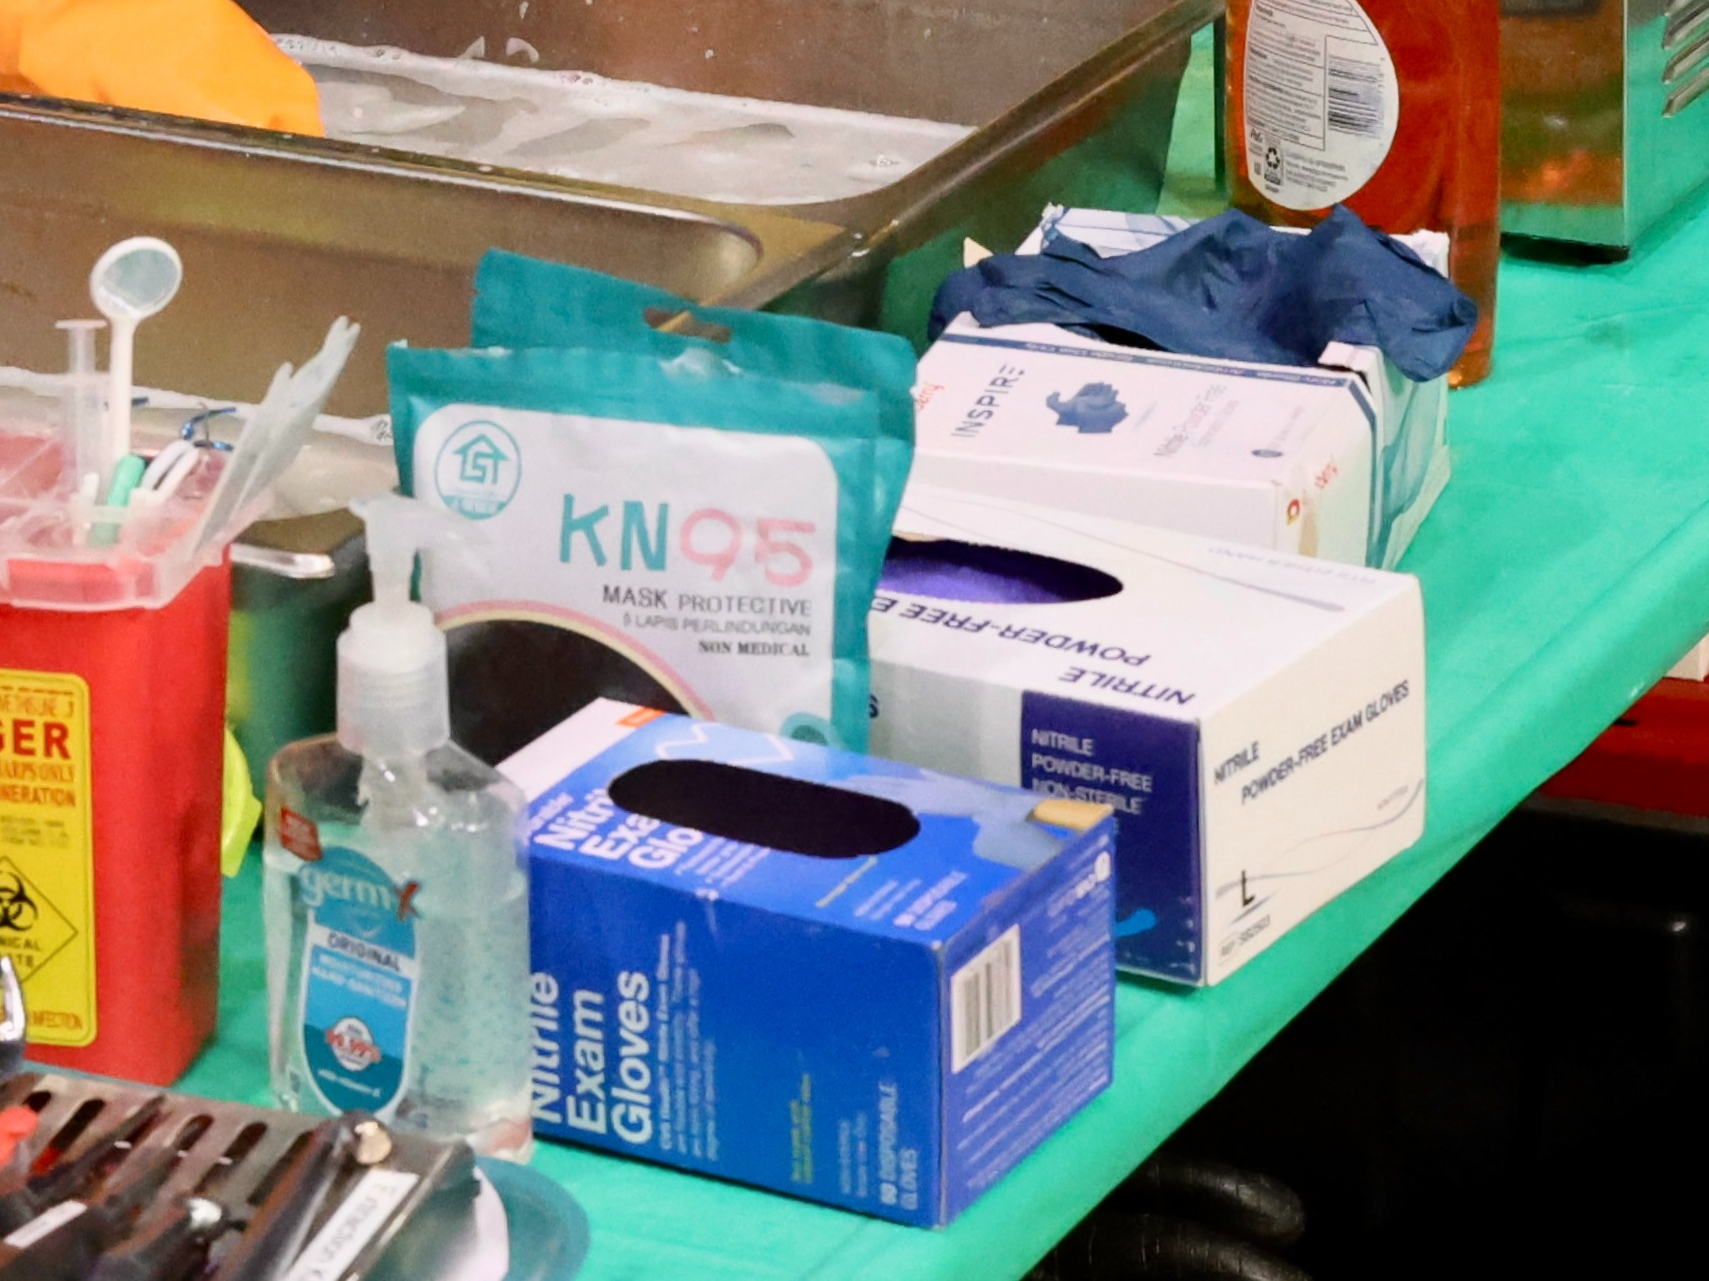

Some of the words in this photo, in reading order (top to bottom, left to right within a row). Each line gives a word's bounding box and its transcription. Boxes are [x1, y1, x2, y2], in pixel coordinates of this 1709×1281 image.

[951, 364, 1026, 439] INSPIRE
[558, 493, 817, 588] KN95
[602, 584, 668, 610] MASK
[678, 593, 812, 618] PROTECTIVE
[635, 614, 679, 631] LAPIS
[681, 616, 812, 637] PERLINDUNGAN
[698, 640, 732, 655] NON
[736, 641, 811, 657] MEDICAL
[899, 600, 1151, 667] POWDER-FREE
[1056, 664, 1195, 705] NITRILE
[1031, 728, 1094, 757] NITRILE
[1213, 740, 1260, 786] NITRILE
[1241, 733, 1328, 806] POWDER-FREE
[1330, 710, 1363, 747] EXAM
[1365, 679, 1410, 723] GLOVES
[1031, 752, 1153, 793] POWDER-FREE
[533, 788, 616, 852] Nitri
[578, 813, 662, 861] Exa
[627, 826, 705, 870] Glo
[1241, 869, 1256, 908] L
[327, 931, 401, 973] ORIGINAL
[529, 971, 563, 1125] Nitrile
[565, 987, 608, 1136] Exam
[609, 969, 652, 1144] Gloves
